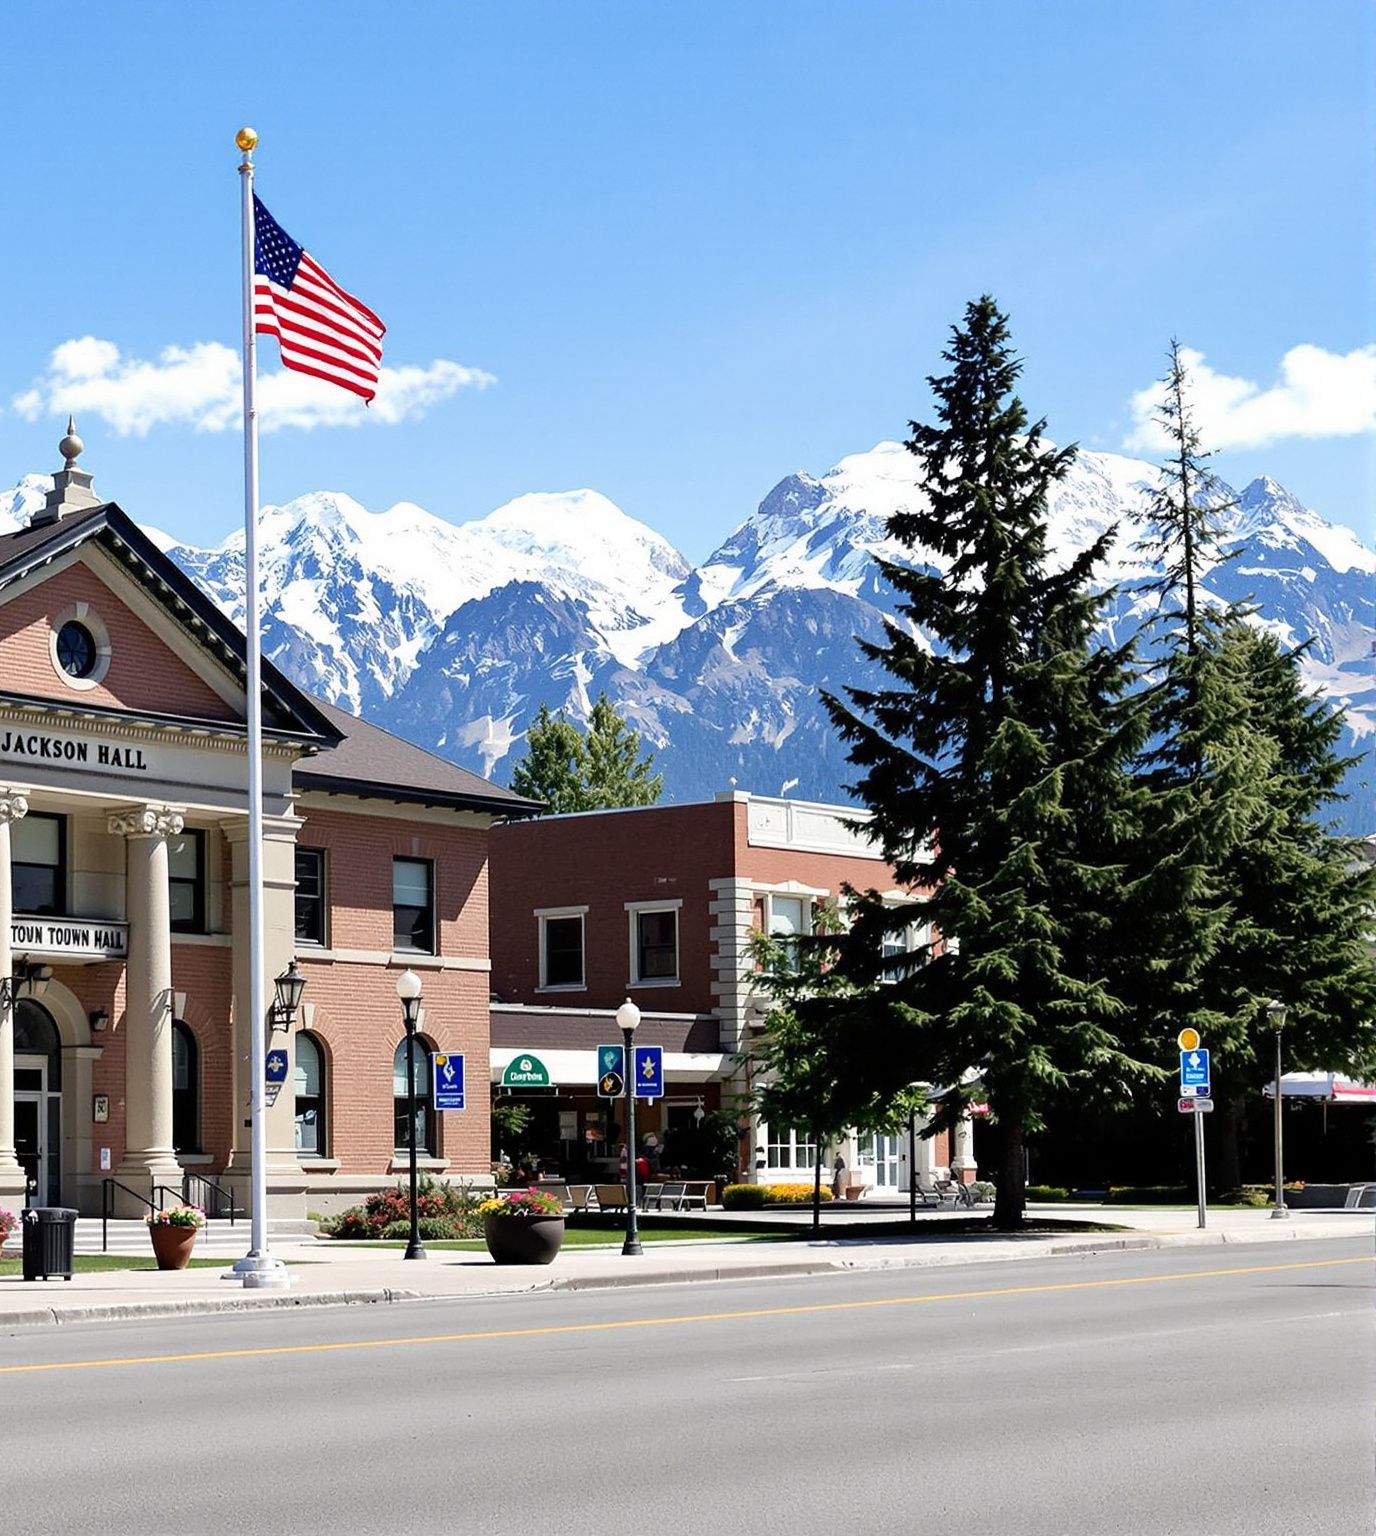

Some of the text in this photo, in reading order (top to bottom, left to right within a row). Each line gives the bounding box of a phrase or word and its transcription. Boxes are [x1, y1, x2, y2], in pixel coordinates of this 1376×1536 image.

[1, 732, 147, 770] JACKSON HALL
[10, 925, 43, 944] TOUN
